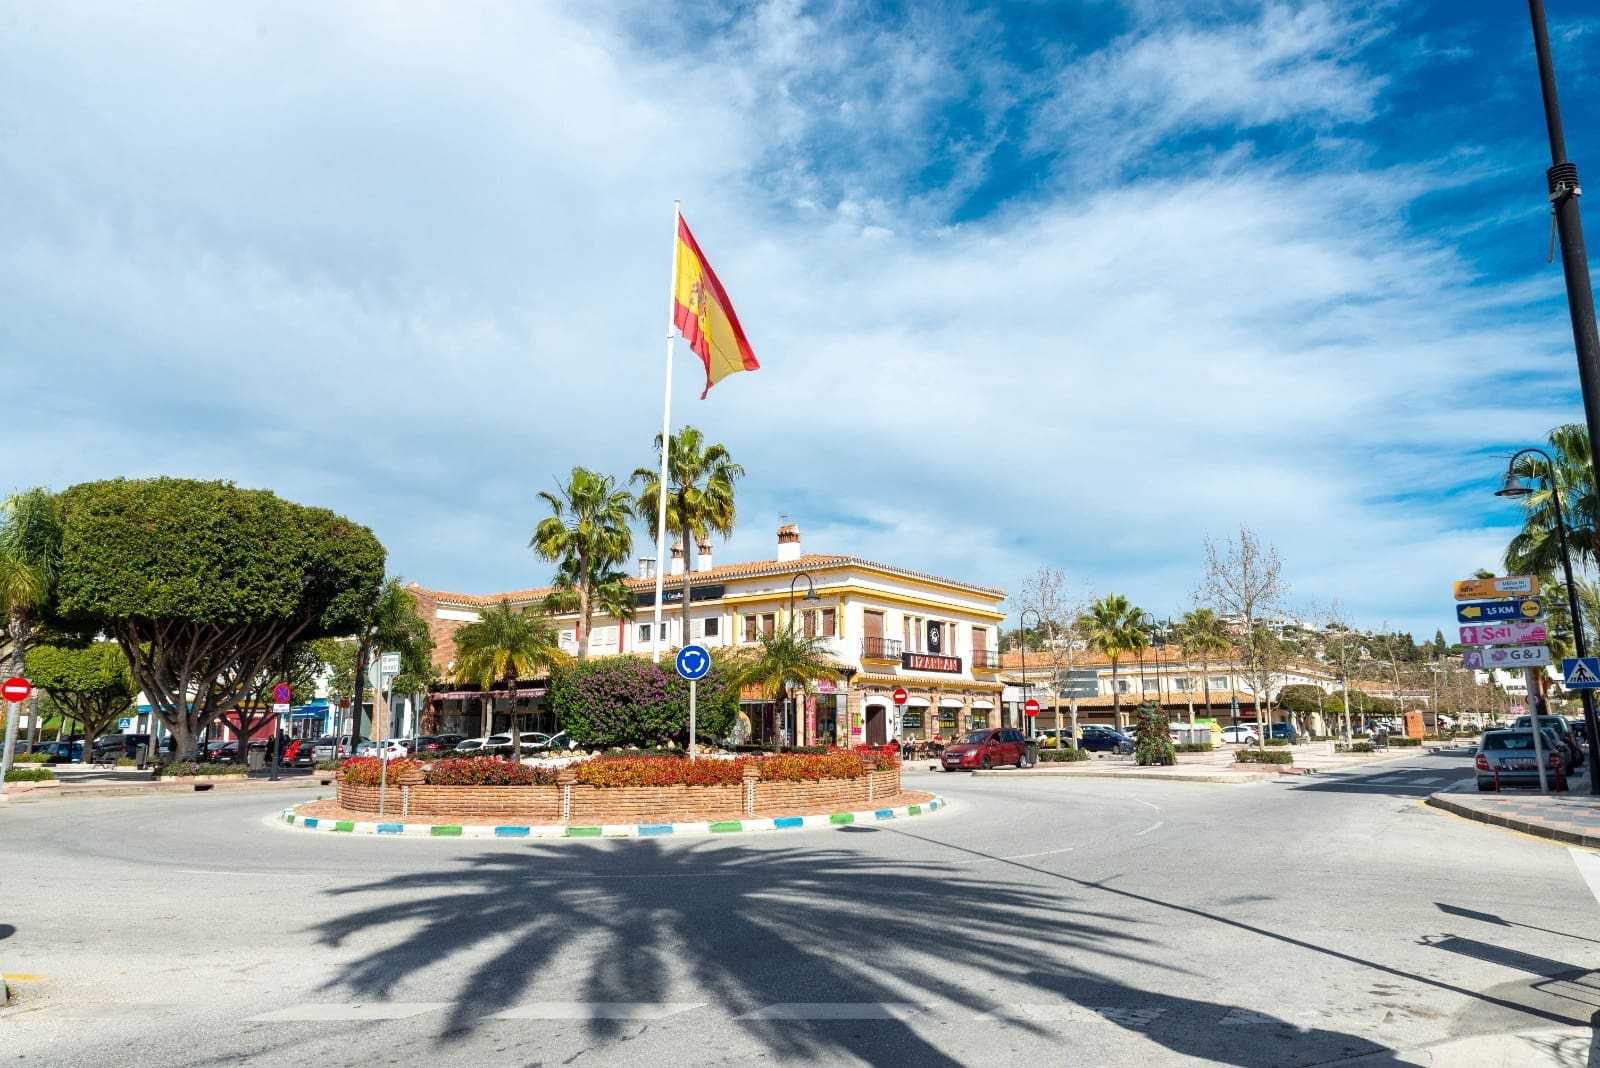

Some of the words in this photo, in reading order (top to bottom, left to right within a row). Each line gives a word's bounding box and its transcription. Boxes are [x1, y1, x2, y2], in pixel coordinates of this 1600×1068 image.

[1498, 606, 1514, 614] KM
[1510, 650, 1520, 660] G
[1523, 649, 1533, 659] &
[1535, 648, 1541, 658] J
